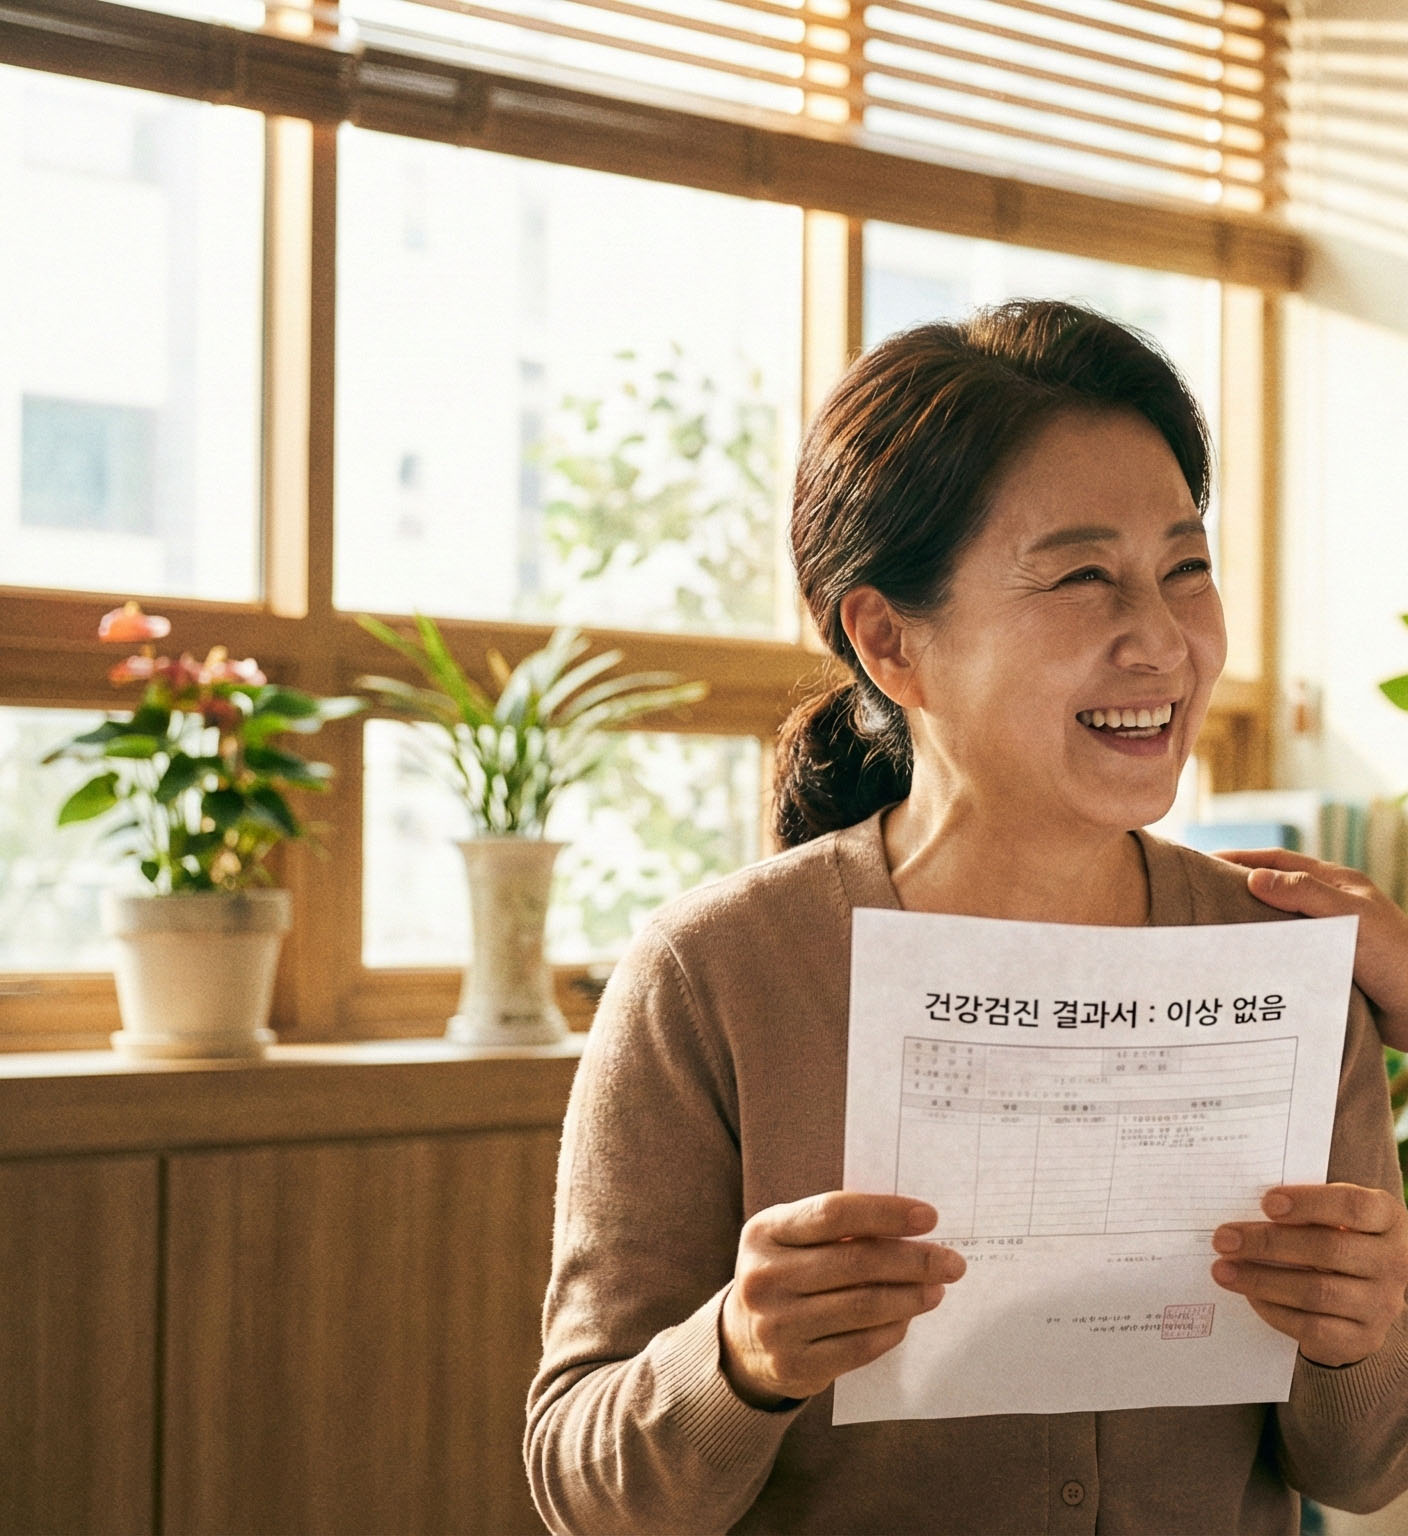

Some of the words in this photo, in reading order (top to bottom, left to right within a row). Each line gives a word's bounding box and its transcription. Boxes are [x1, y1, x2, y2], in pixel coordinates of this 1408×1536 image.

[924, 992, 1040, 1028] 건강검진
[1052, 999, 1138, 1029] 결과서
[1148, 1004, 1156, 1023] :
[1166, 996, 1223, 1028] 이상
[1232, 993, 1287, 1025] 없음
